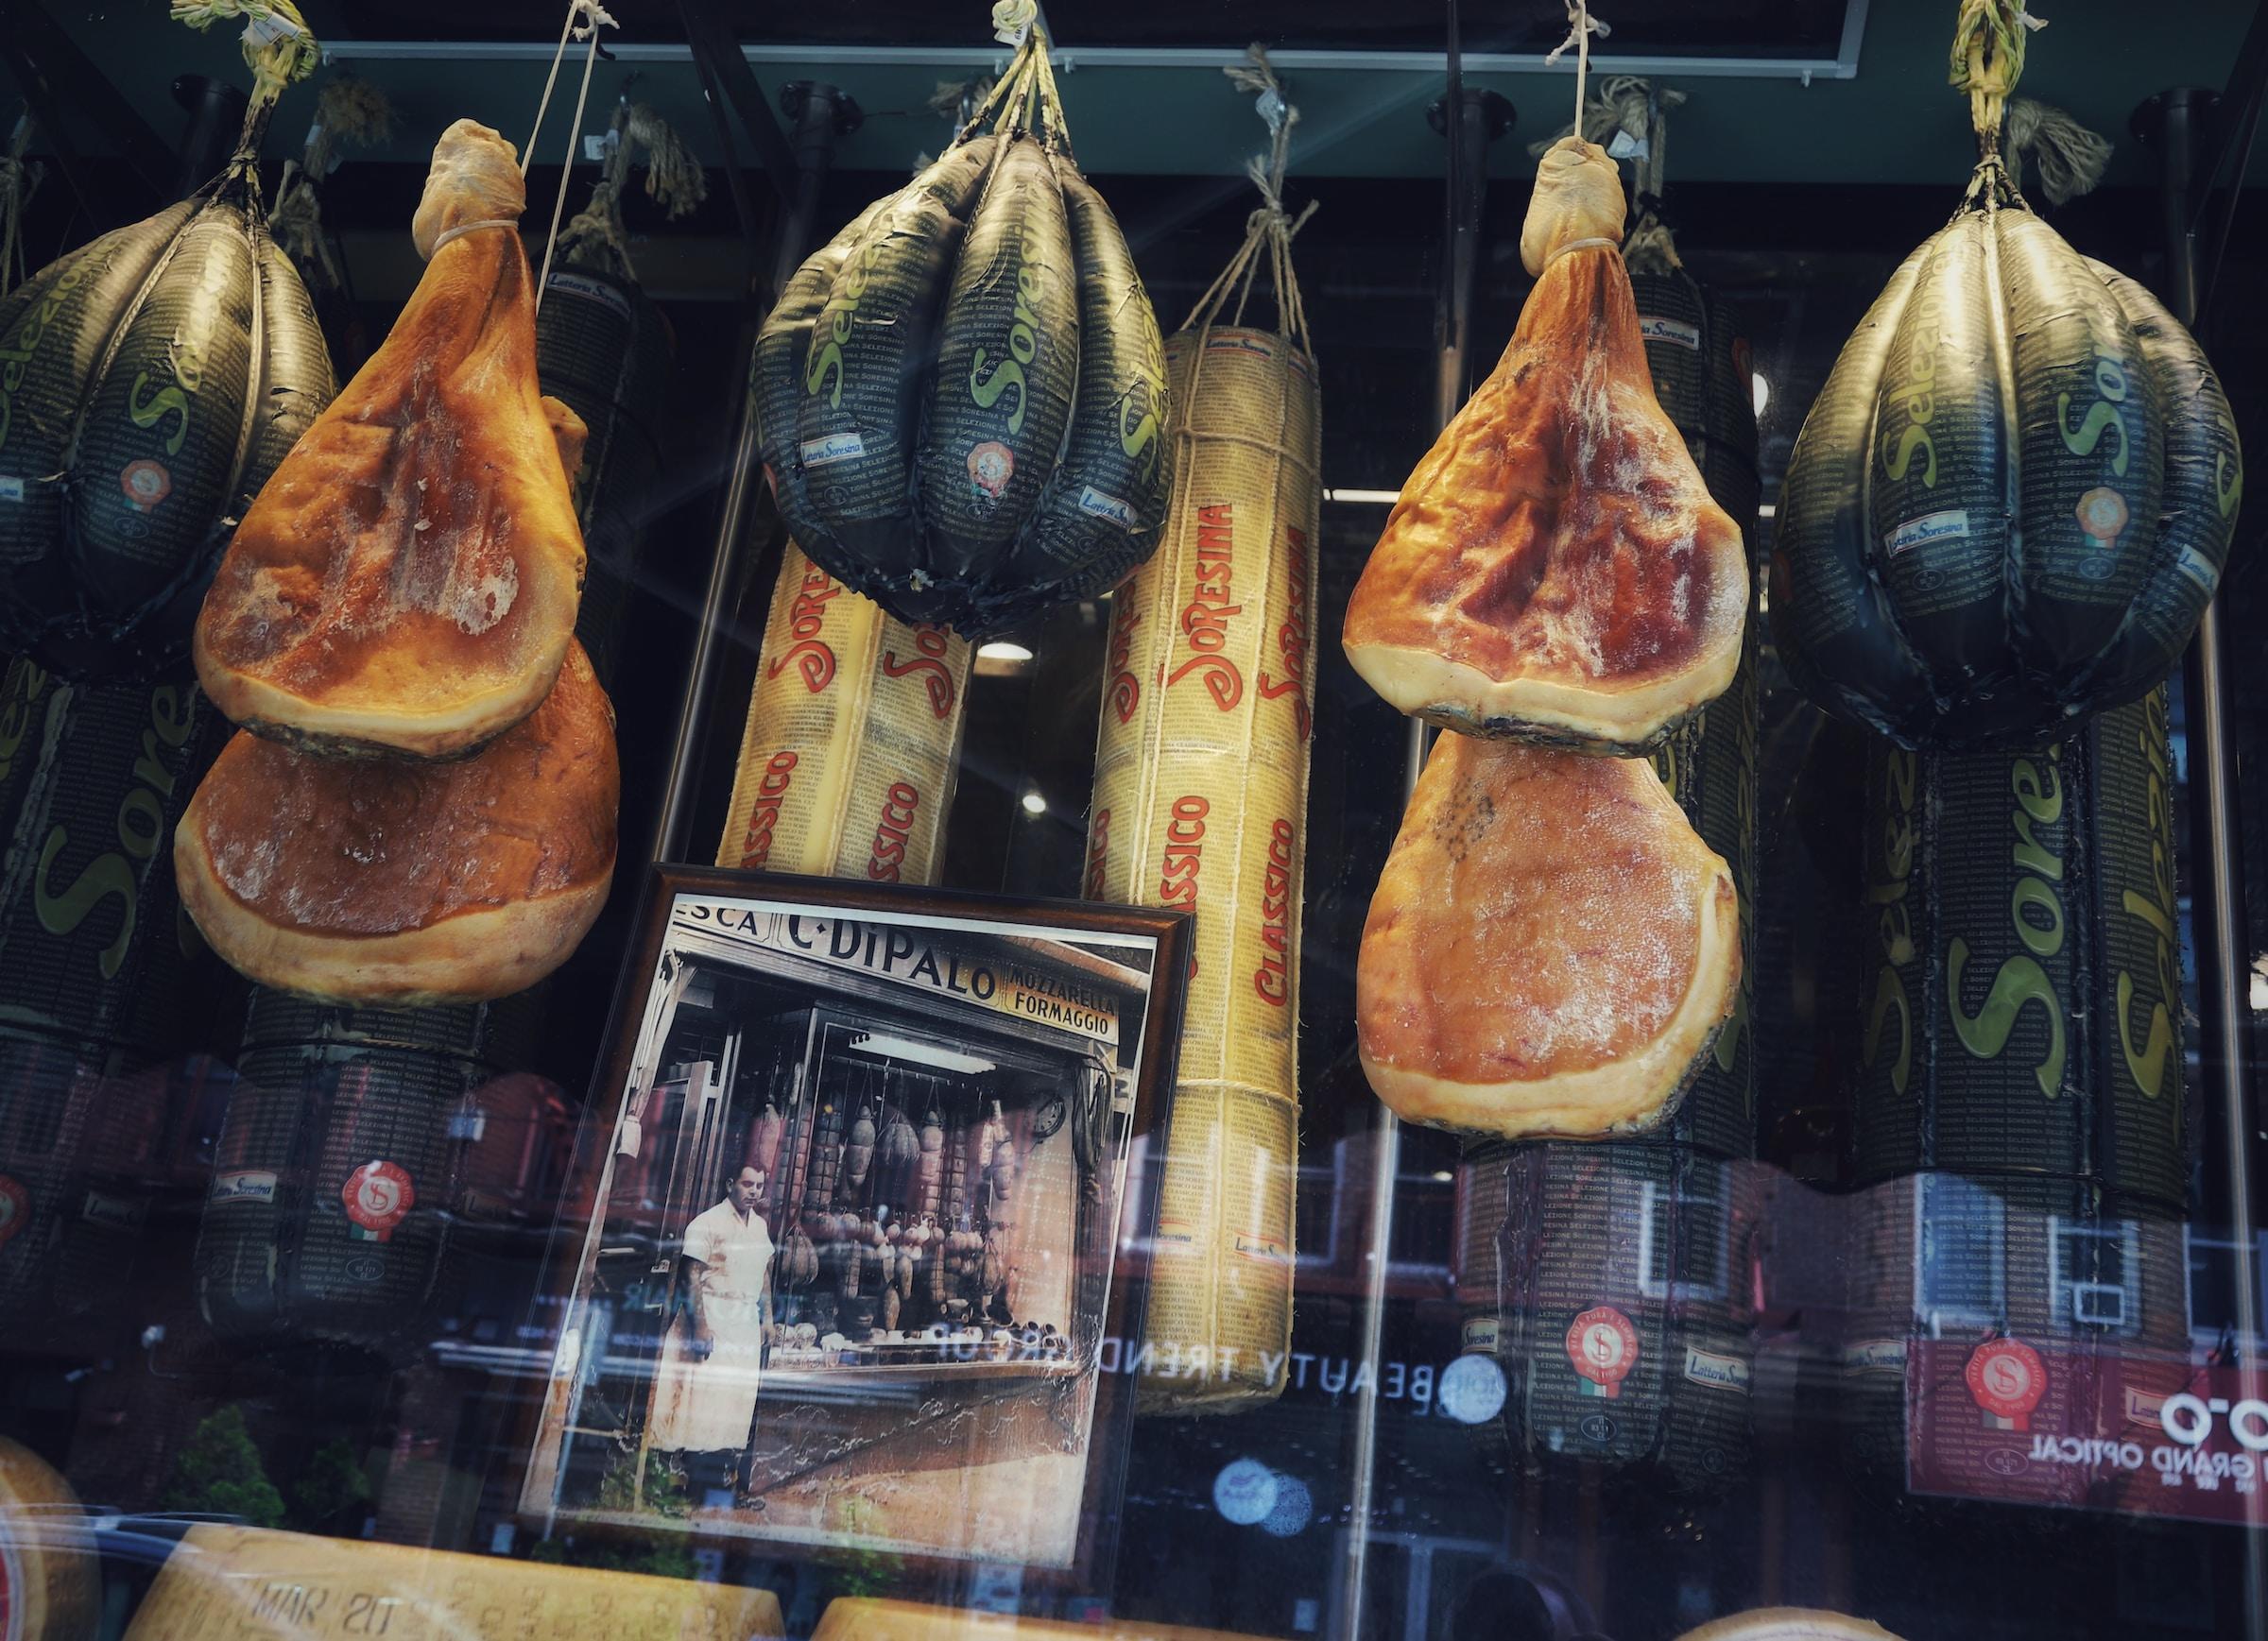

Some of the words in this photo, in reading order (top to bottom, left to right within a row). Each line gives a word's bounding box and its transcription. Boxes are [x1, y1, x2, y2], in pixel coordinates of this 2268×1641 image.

[826, 441, 861, 457] Soresina
[1918, 522, 1963, 539] Soresina
[1158, 504, 1242, 712] SORESINA
[1254, 818, 1295, 1007] CLASSICO
[1948, 743, 2068, 1100] Sore
[1010, 966, 1115, 1017] MOZZARELLA
[1015, 990, 1108, 1035] FORMAGGIO
[233, 1177, 272, 1195] Soresina
[1690, 1356, 1727, 1381] Latteria
